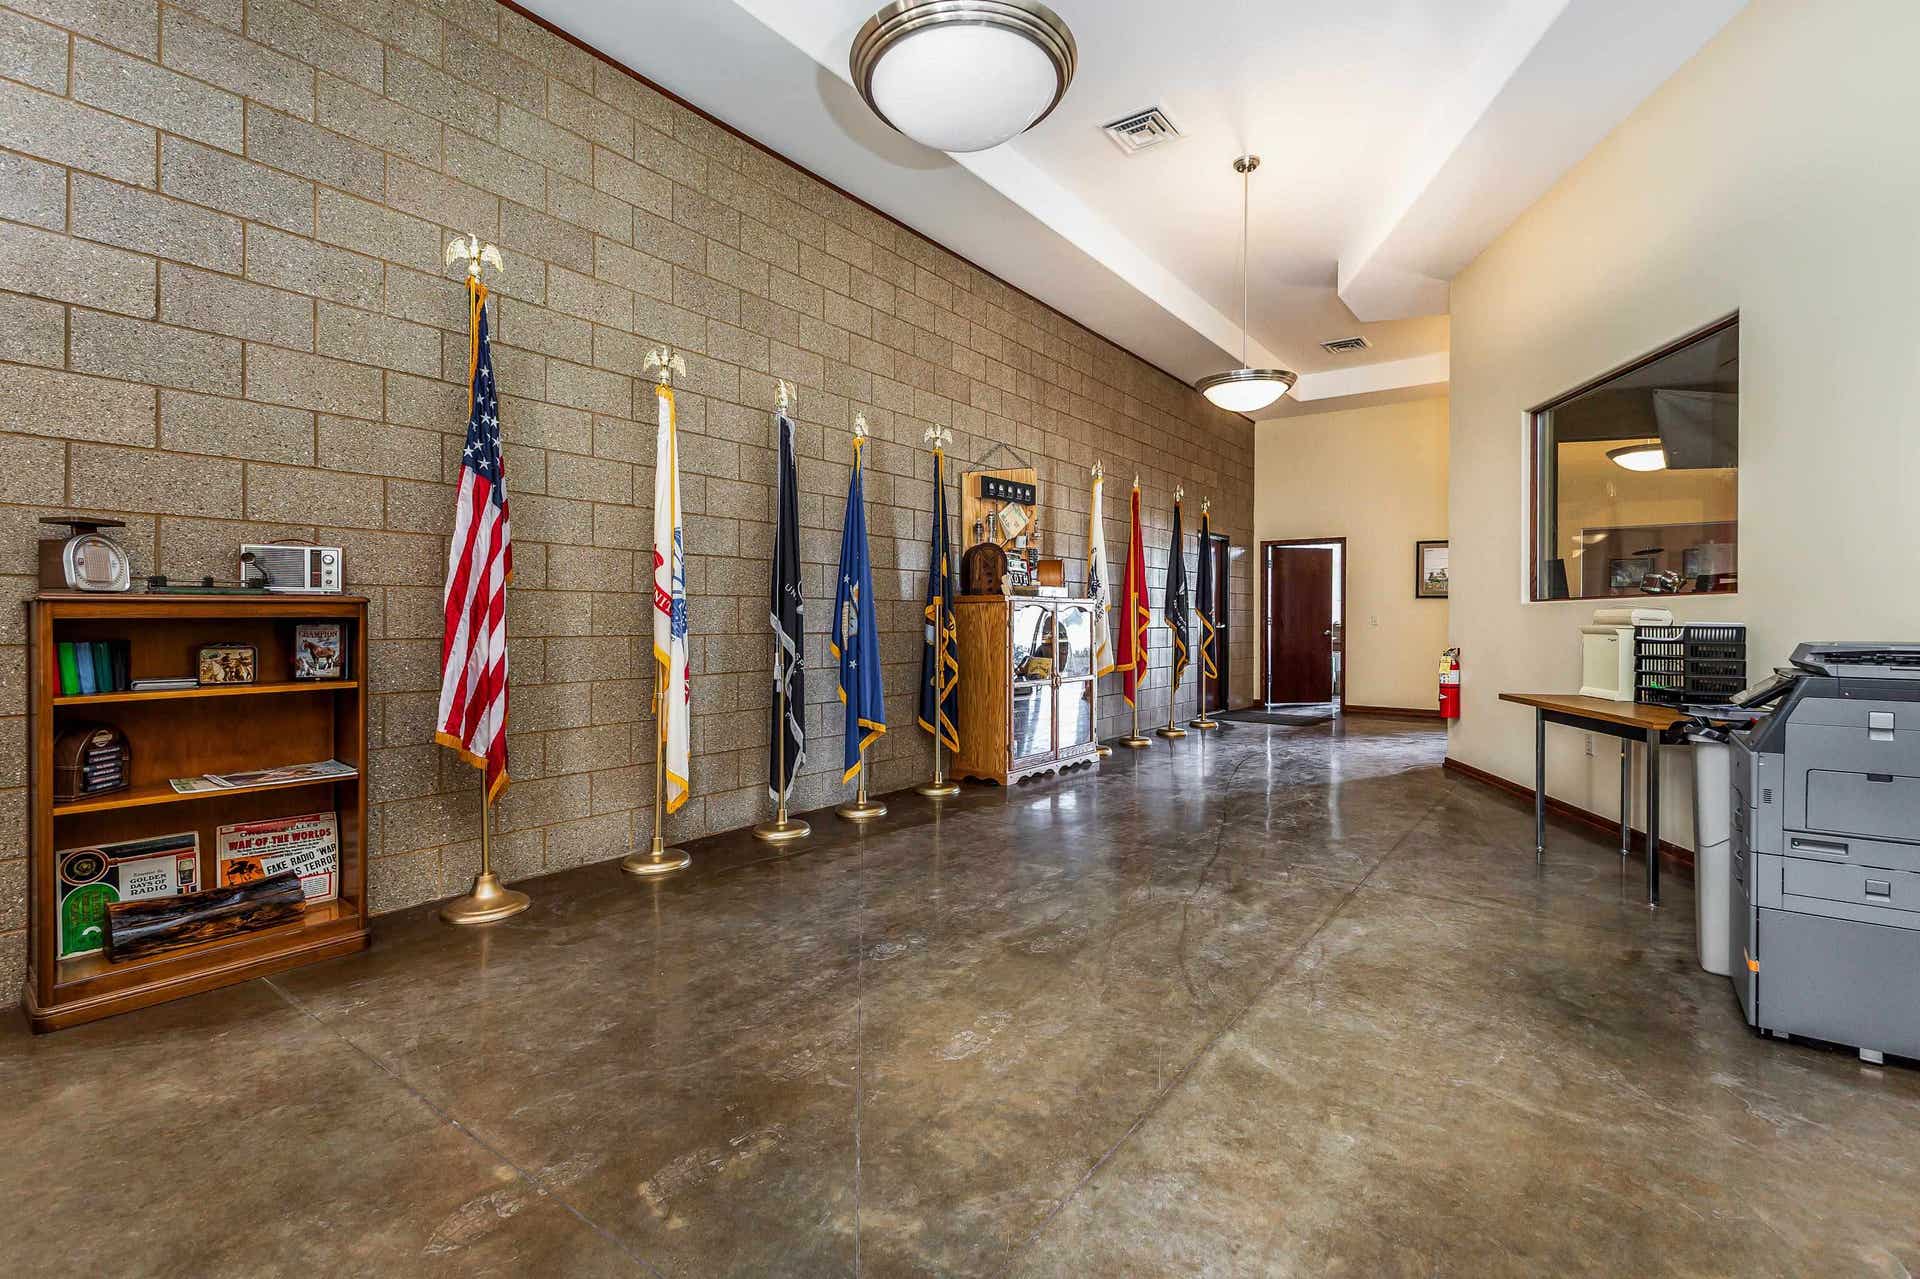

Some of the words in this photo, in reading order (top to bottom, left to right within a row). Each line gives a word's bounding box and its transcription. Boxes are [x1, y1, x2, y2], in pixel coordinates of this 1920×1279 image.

[228, 839, 252, 851] WAR
[255, 838, 269, 847] OF
[272, 834, 289, 845] THE
[292, 828, 332, 841] WORLDS
[266, 860, 288, 875] FAKE
[290, 851, 315, 867] RADIO
[130, 873, 167, 884] GOLDEN
[130, 881, 153, 889] DAYS
[130, 884, 167, 896] RADIO
